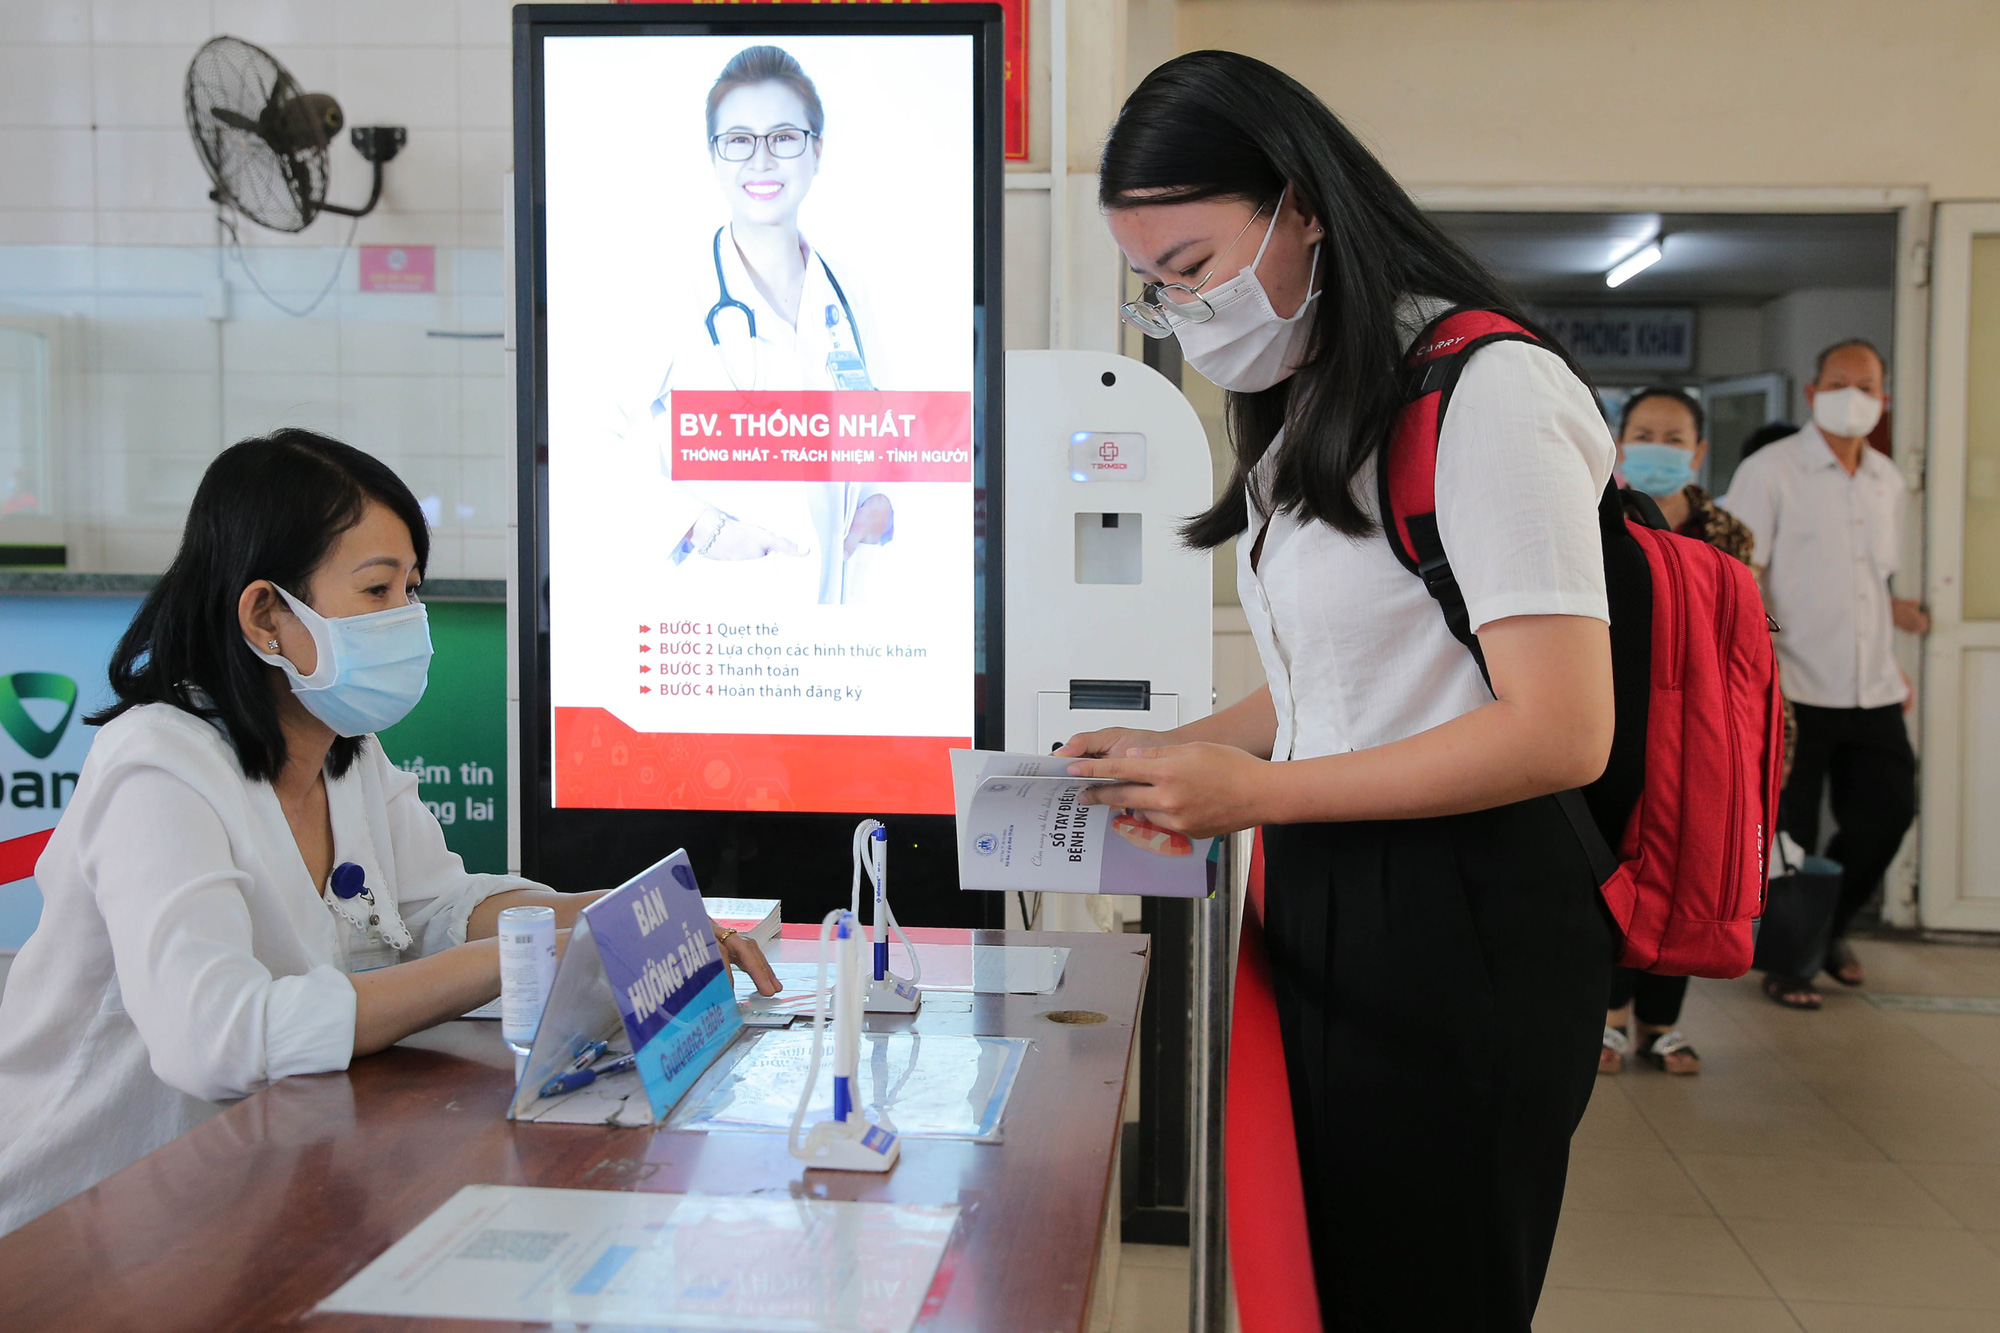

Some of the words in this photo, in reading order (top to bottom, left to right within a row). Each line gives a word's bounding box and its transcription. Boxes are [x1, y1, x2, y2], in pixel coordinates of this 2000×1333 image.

[680, 413, 722, 436] BV.
[730, 408, 831, 437] THỐNG
[839, 409, 916, 437] NHẤT
[781, 447, 828, 462] TRÁCH
[831, 448, 875, 465] NHIỆM
[886, 447, 918, 462] TÌNH
[921, 447, 968, 462] NGƯỜI
[660, 620, 701, 634] BƯỚC
[706, 623, 713, 634] 1
[718, 623, 752, 638] Quẹt
[660, 640, 701, 655] BƯỚC
[706, 643, 713, 655] 2
[718, 643, 742, 658] Lựa
[747, 643, 782, 659] chọn
[786, 643, 810, 656] các
[850, 644, 882, 657] thức
[886, 644, 927, 657] khám
[660, 661, 701, 675] BƯỚC
[706, 664, 713, 675] 3
[718, 663, 762, 676] Thanh
[767, 663, 799, 677] toán
[660, 681, 701, 696] BƯỚC
[705, 684, 713, 696] 4
[806, 684, 842, 701] đăng
[846, 684, 862, 701] ký
[459, 761, 494, 785] tin
[466, 796, 494, 821] lai
[1073, 806, 1090, 828] UNG
[1054, 812, 1070, 831] TAY
[1049, 832, 1066, 847] SỔ
[1067, 831, 1086, 862] BỆNH
[632, 885, 669, 937] BÀN
[677, 921, 711, 981] DẪN
[660, 1024, 705, 1082] Guidance
[701, 1003, 725, 1044] table
